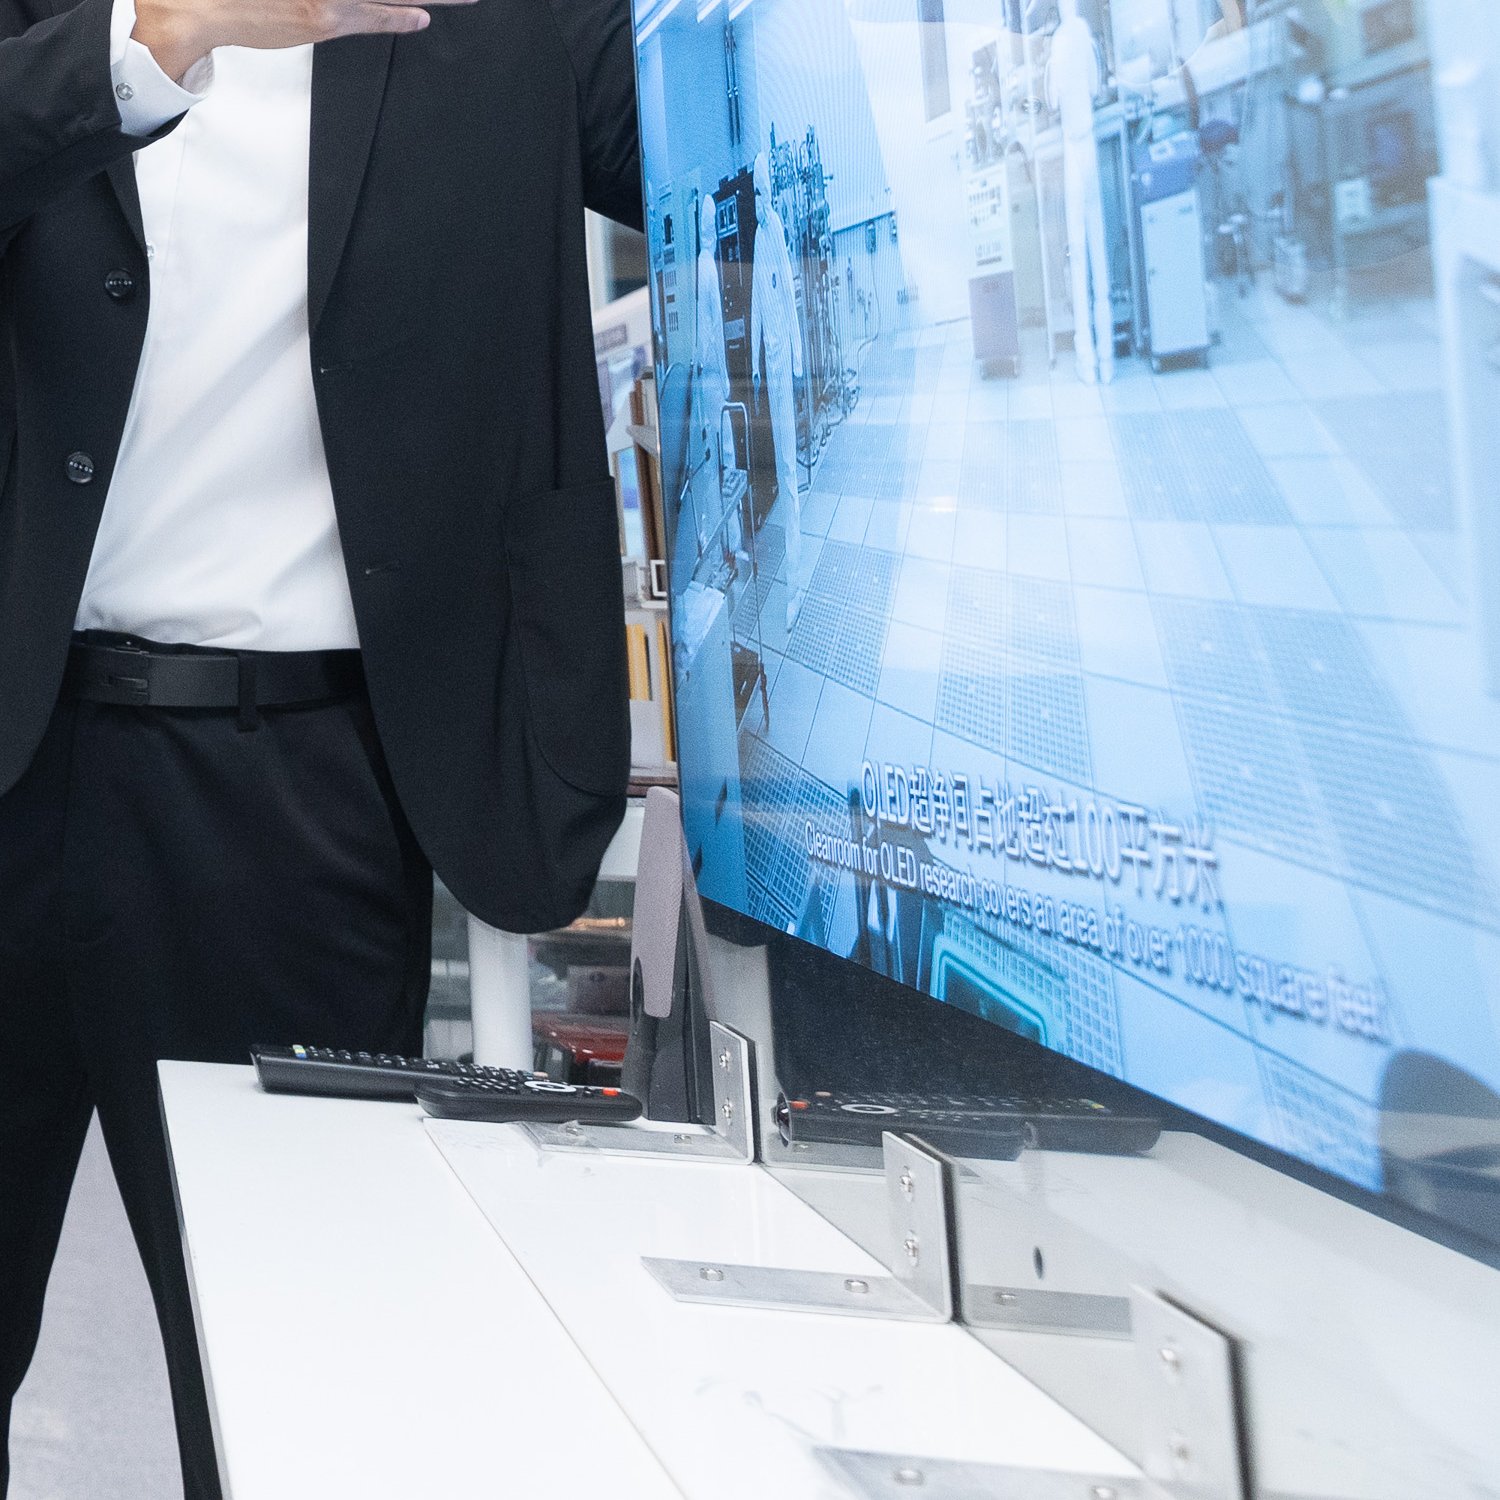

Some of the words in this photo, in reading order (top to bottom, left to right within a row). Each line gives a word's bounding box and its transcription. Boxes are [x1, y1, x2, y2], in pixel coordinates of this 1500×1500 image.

[805, 821, 860, 870] Cleanroom
[861, 837, 879, 875] for
[881, 842, 917, 888] OLED
[920, 864, 977, 908] research
[982, 880, 1030, 925] covers
[1035, 895, 1056, 932] an
[1060, 900, 1099, 946] area
[1103, 904, 1122, 957] of
[1126, 920, 1171, 970] over
[1175, 928, 1234, 989] 1000
[1235, 955, 1328, 1021] square
[862, 760, 1221, 908] OLED超净间占地超过100平方米
